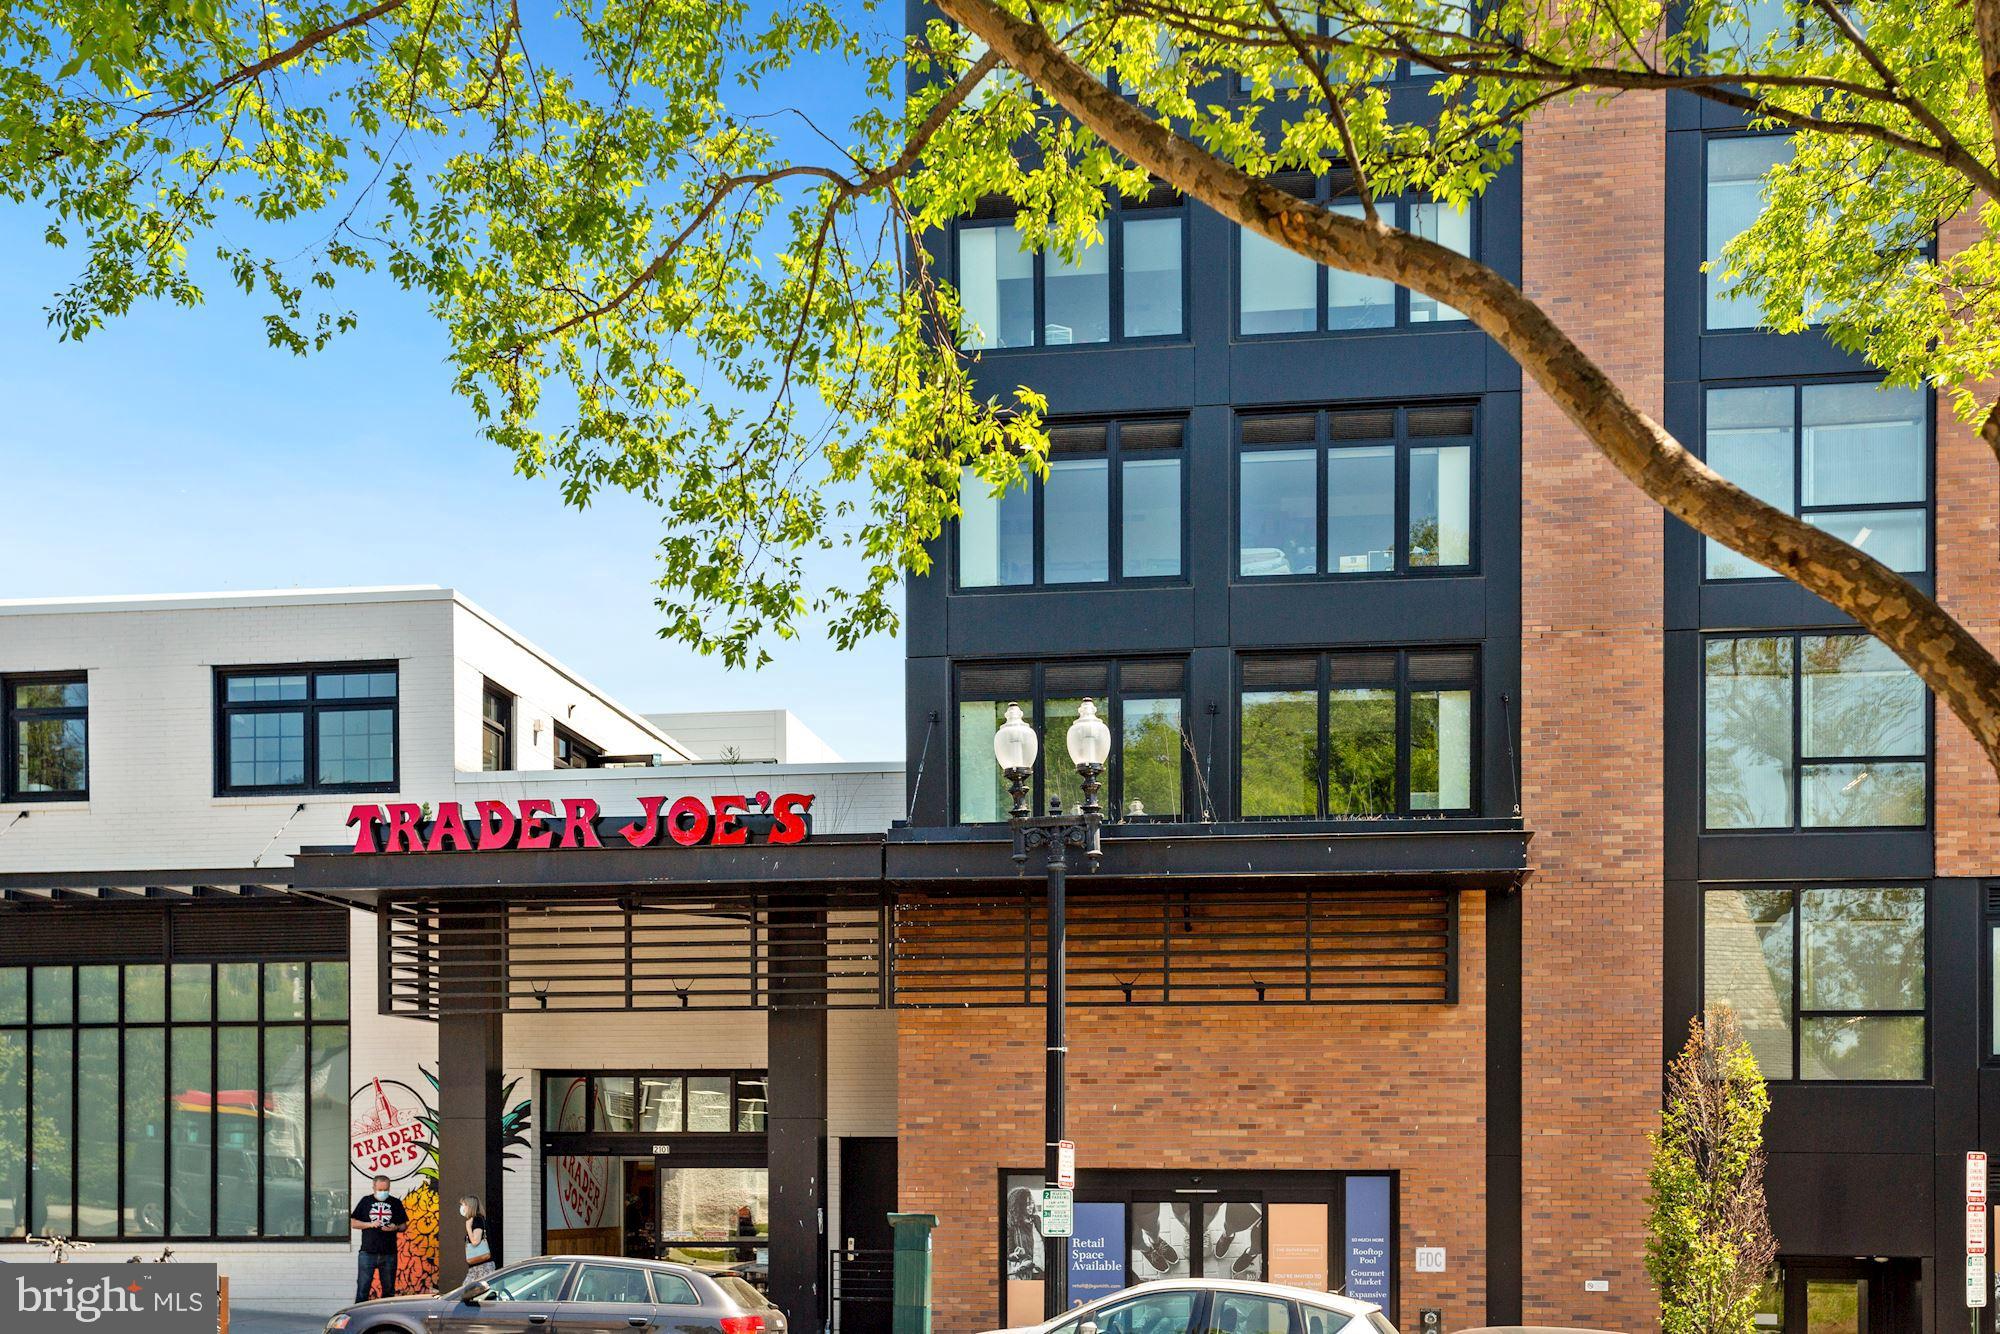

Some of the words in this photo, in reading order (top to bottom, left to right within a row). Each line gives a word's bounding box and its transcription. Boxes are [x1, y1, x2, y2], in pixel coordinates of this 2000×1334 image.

[346, 798, 605, 854] TRADER
[618, 790, 816, 848] JOE'S
[353, 1122, 426, 1159] TRADER
[368, 1144, 418, 1172] JOE'S
[1044, 1191, 1050, 1199] 2
[564, 1180, 593, 1226] JOE'S
[1072, 1238, 1105, 1248] Retail
[1072, 1250, 1104, 1262] Space
[1353, 1248, 1384, 1257] Rooftop
[1420, 1252, 1442, 1267] FDC
[1072, 1261, 1122, 1271] Available
[1351, 1269, 1385, 1277] Gourmet
[1355, 1278, 1382, 1286] Market
[1350, 1291, 1387, 1299] Expansive
